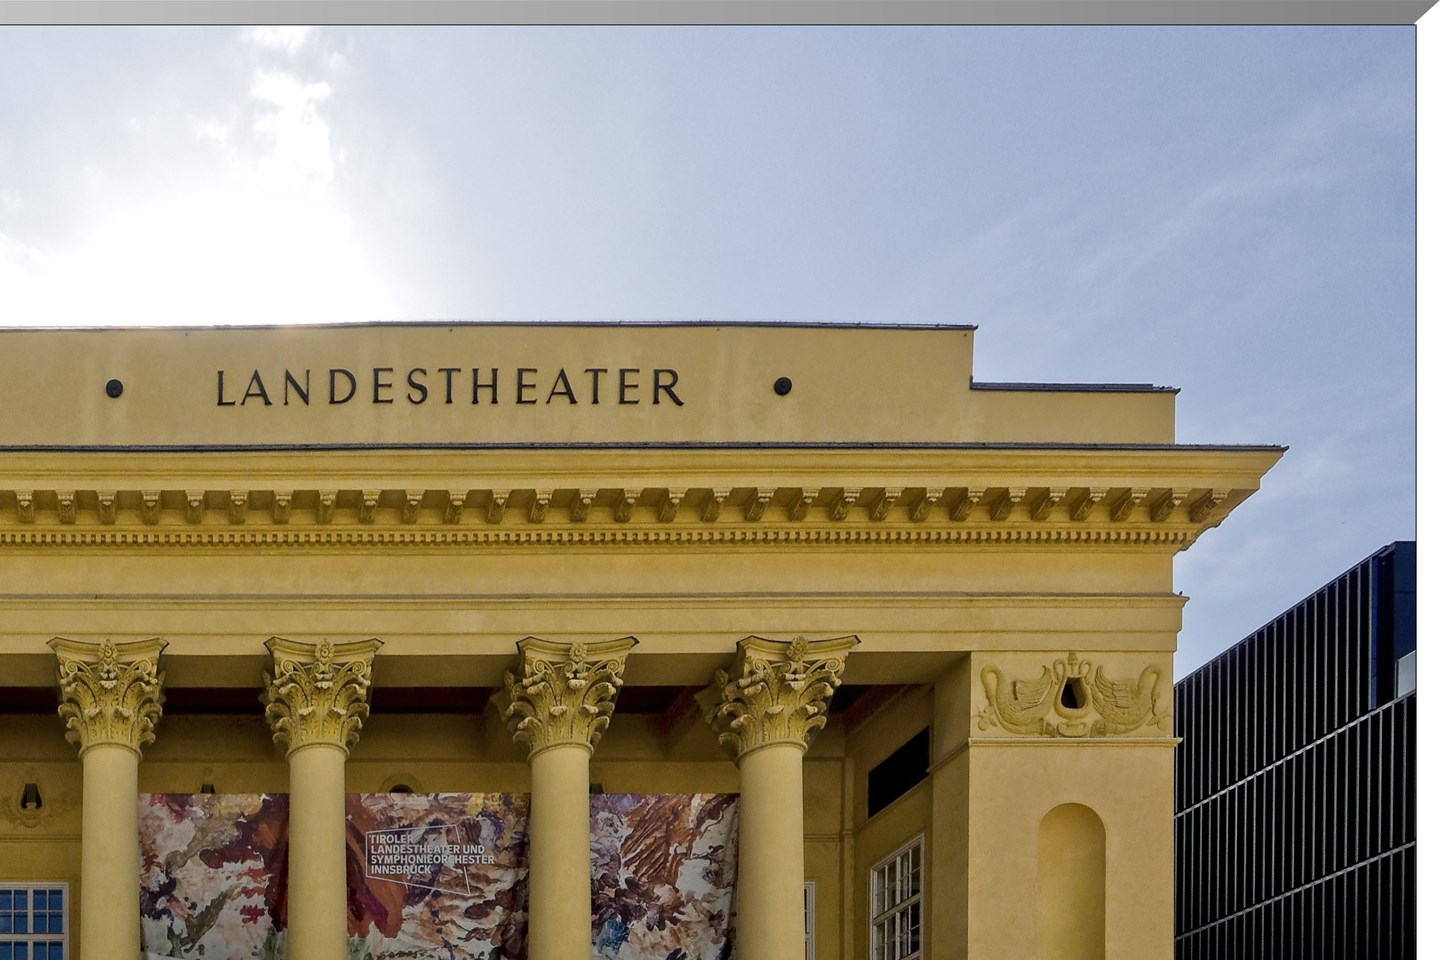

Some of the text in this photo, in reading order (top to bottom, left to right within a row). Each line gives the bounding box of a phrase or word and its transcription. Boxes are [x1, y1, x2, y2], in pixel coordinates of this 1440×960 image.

[217, 367, 685, 406] LANDESTHEATER
[370, 834, 413, 843] TIROLER
[371, 845, 485, 854] LANDESTHEATER UND
[371, 855, 494, 864] SYMPHONIEORCHESTER
[371, 865, 432, 874] INNSBRUCK
